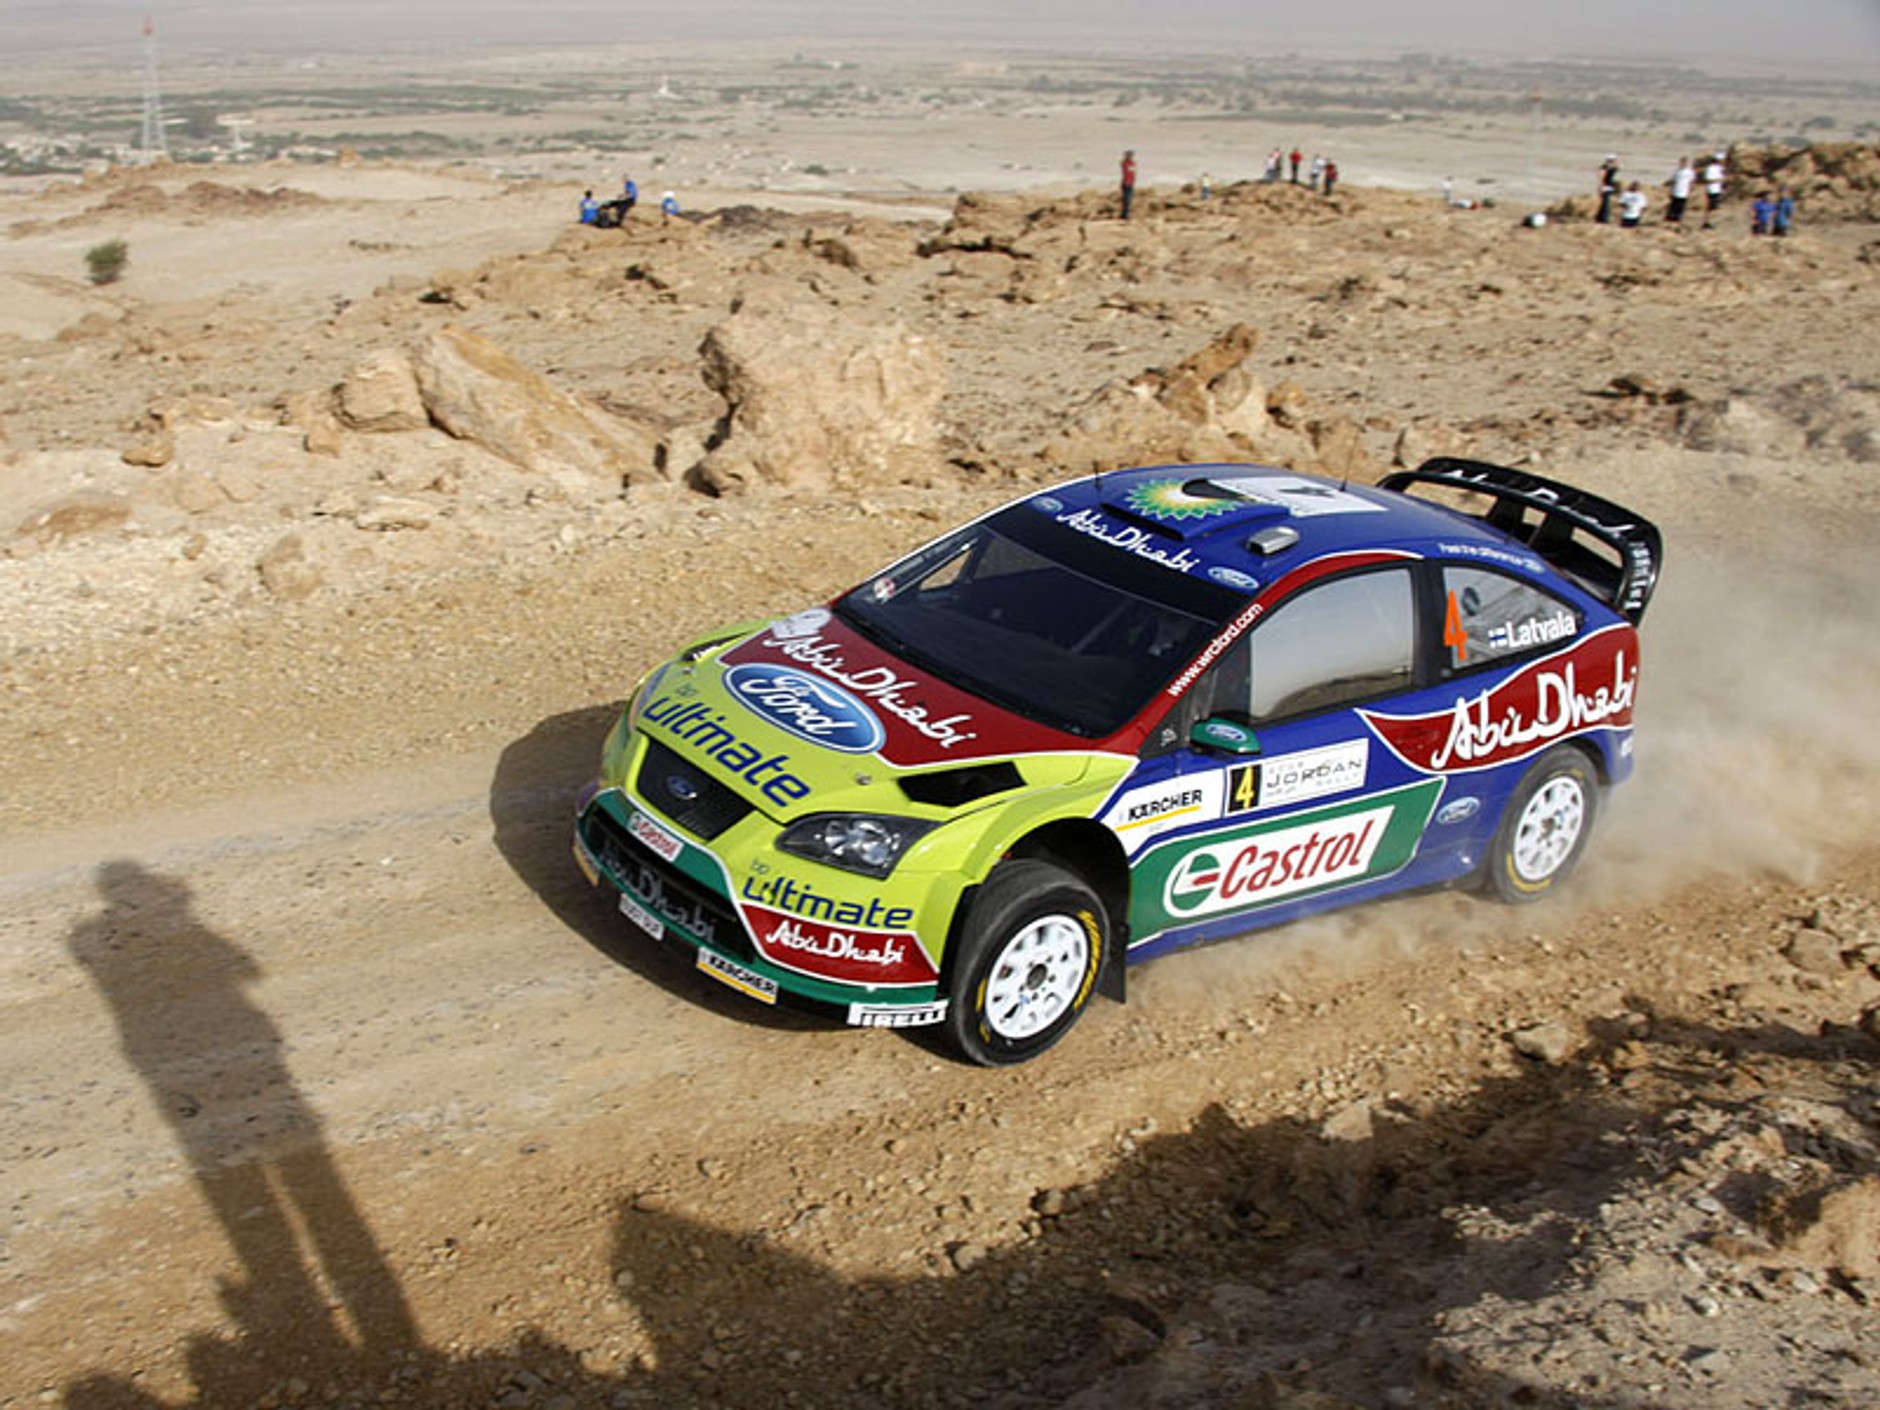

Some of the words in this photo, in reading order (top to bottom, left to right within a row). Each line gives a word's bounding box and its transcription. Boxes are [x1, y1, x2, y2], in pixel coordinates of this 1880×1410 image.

[1443, 589, 1468, 660] 4
[1506, 610, 1577, 648] Latvala
[739, 675, 858, 735] Ford
[642, 697, 811, 808] ultimate
[1267, 759, 1361, 789] JORDAN
[1235, 766, 1254, 810] 4
[1219, 819, 1375, 899] Castrol
[847, 1000, 949, 1028] PIRELLI
